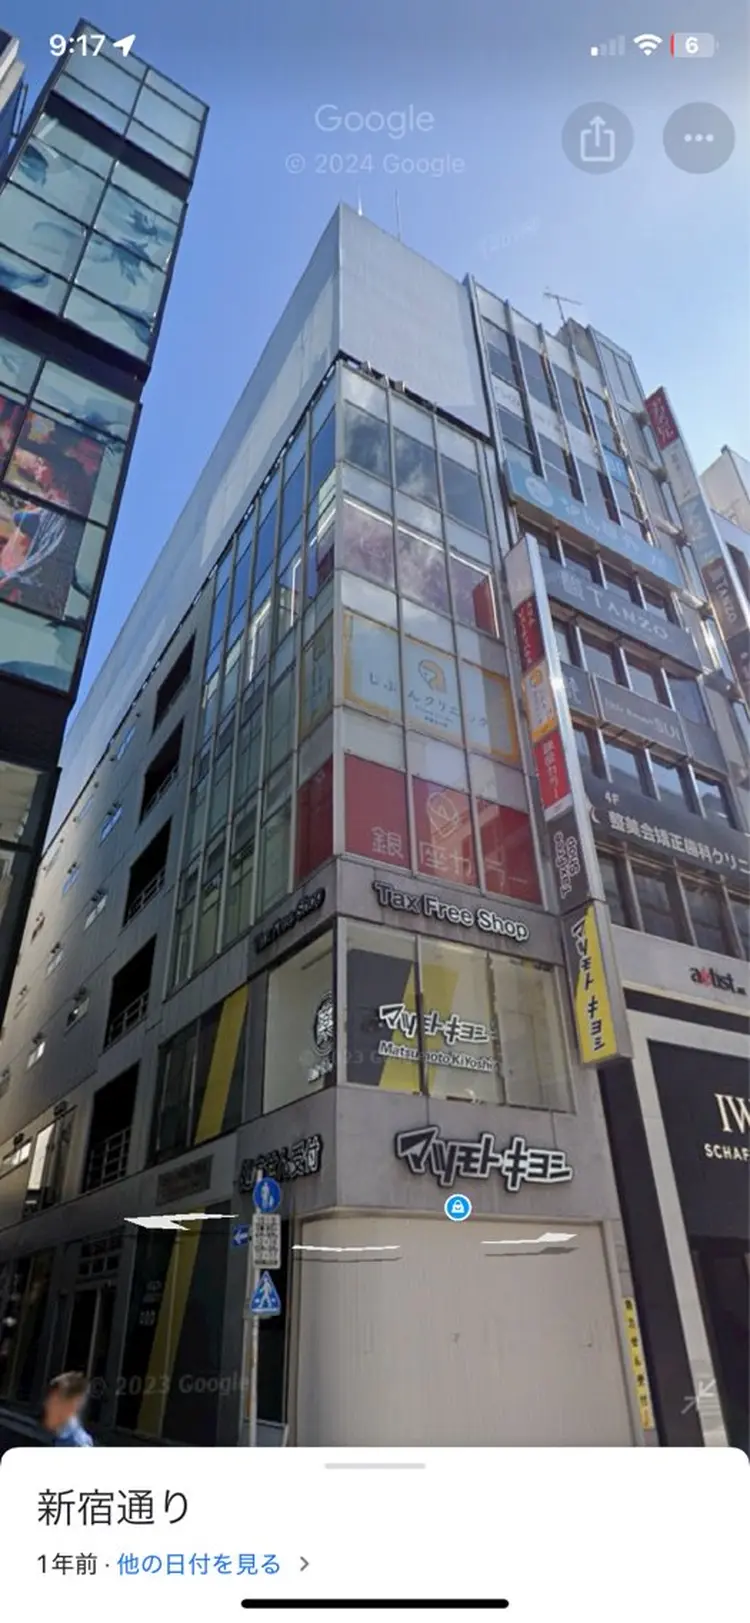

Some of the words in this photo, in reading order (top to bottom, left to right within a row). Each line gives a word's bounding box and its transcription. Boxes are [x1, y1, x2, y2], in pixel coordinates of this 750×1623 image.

[374, 881, 422, 914] Tax
[423, 892, 474, 926] Free
[476, 907, 529, 941] Shop
[571, 916, 605, 1051] マツモトキヨシ
[394, 1125, 574, 1192] マツモトキヨシ
